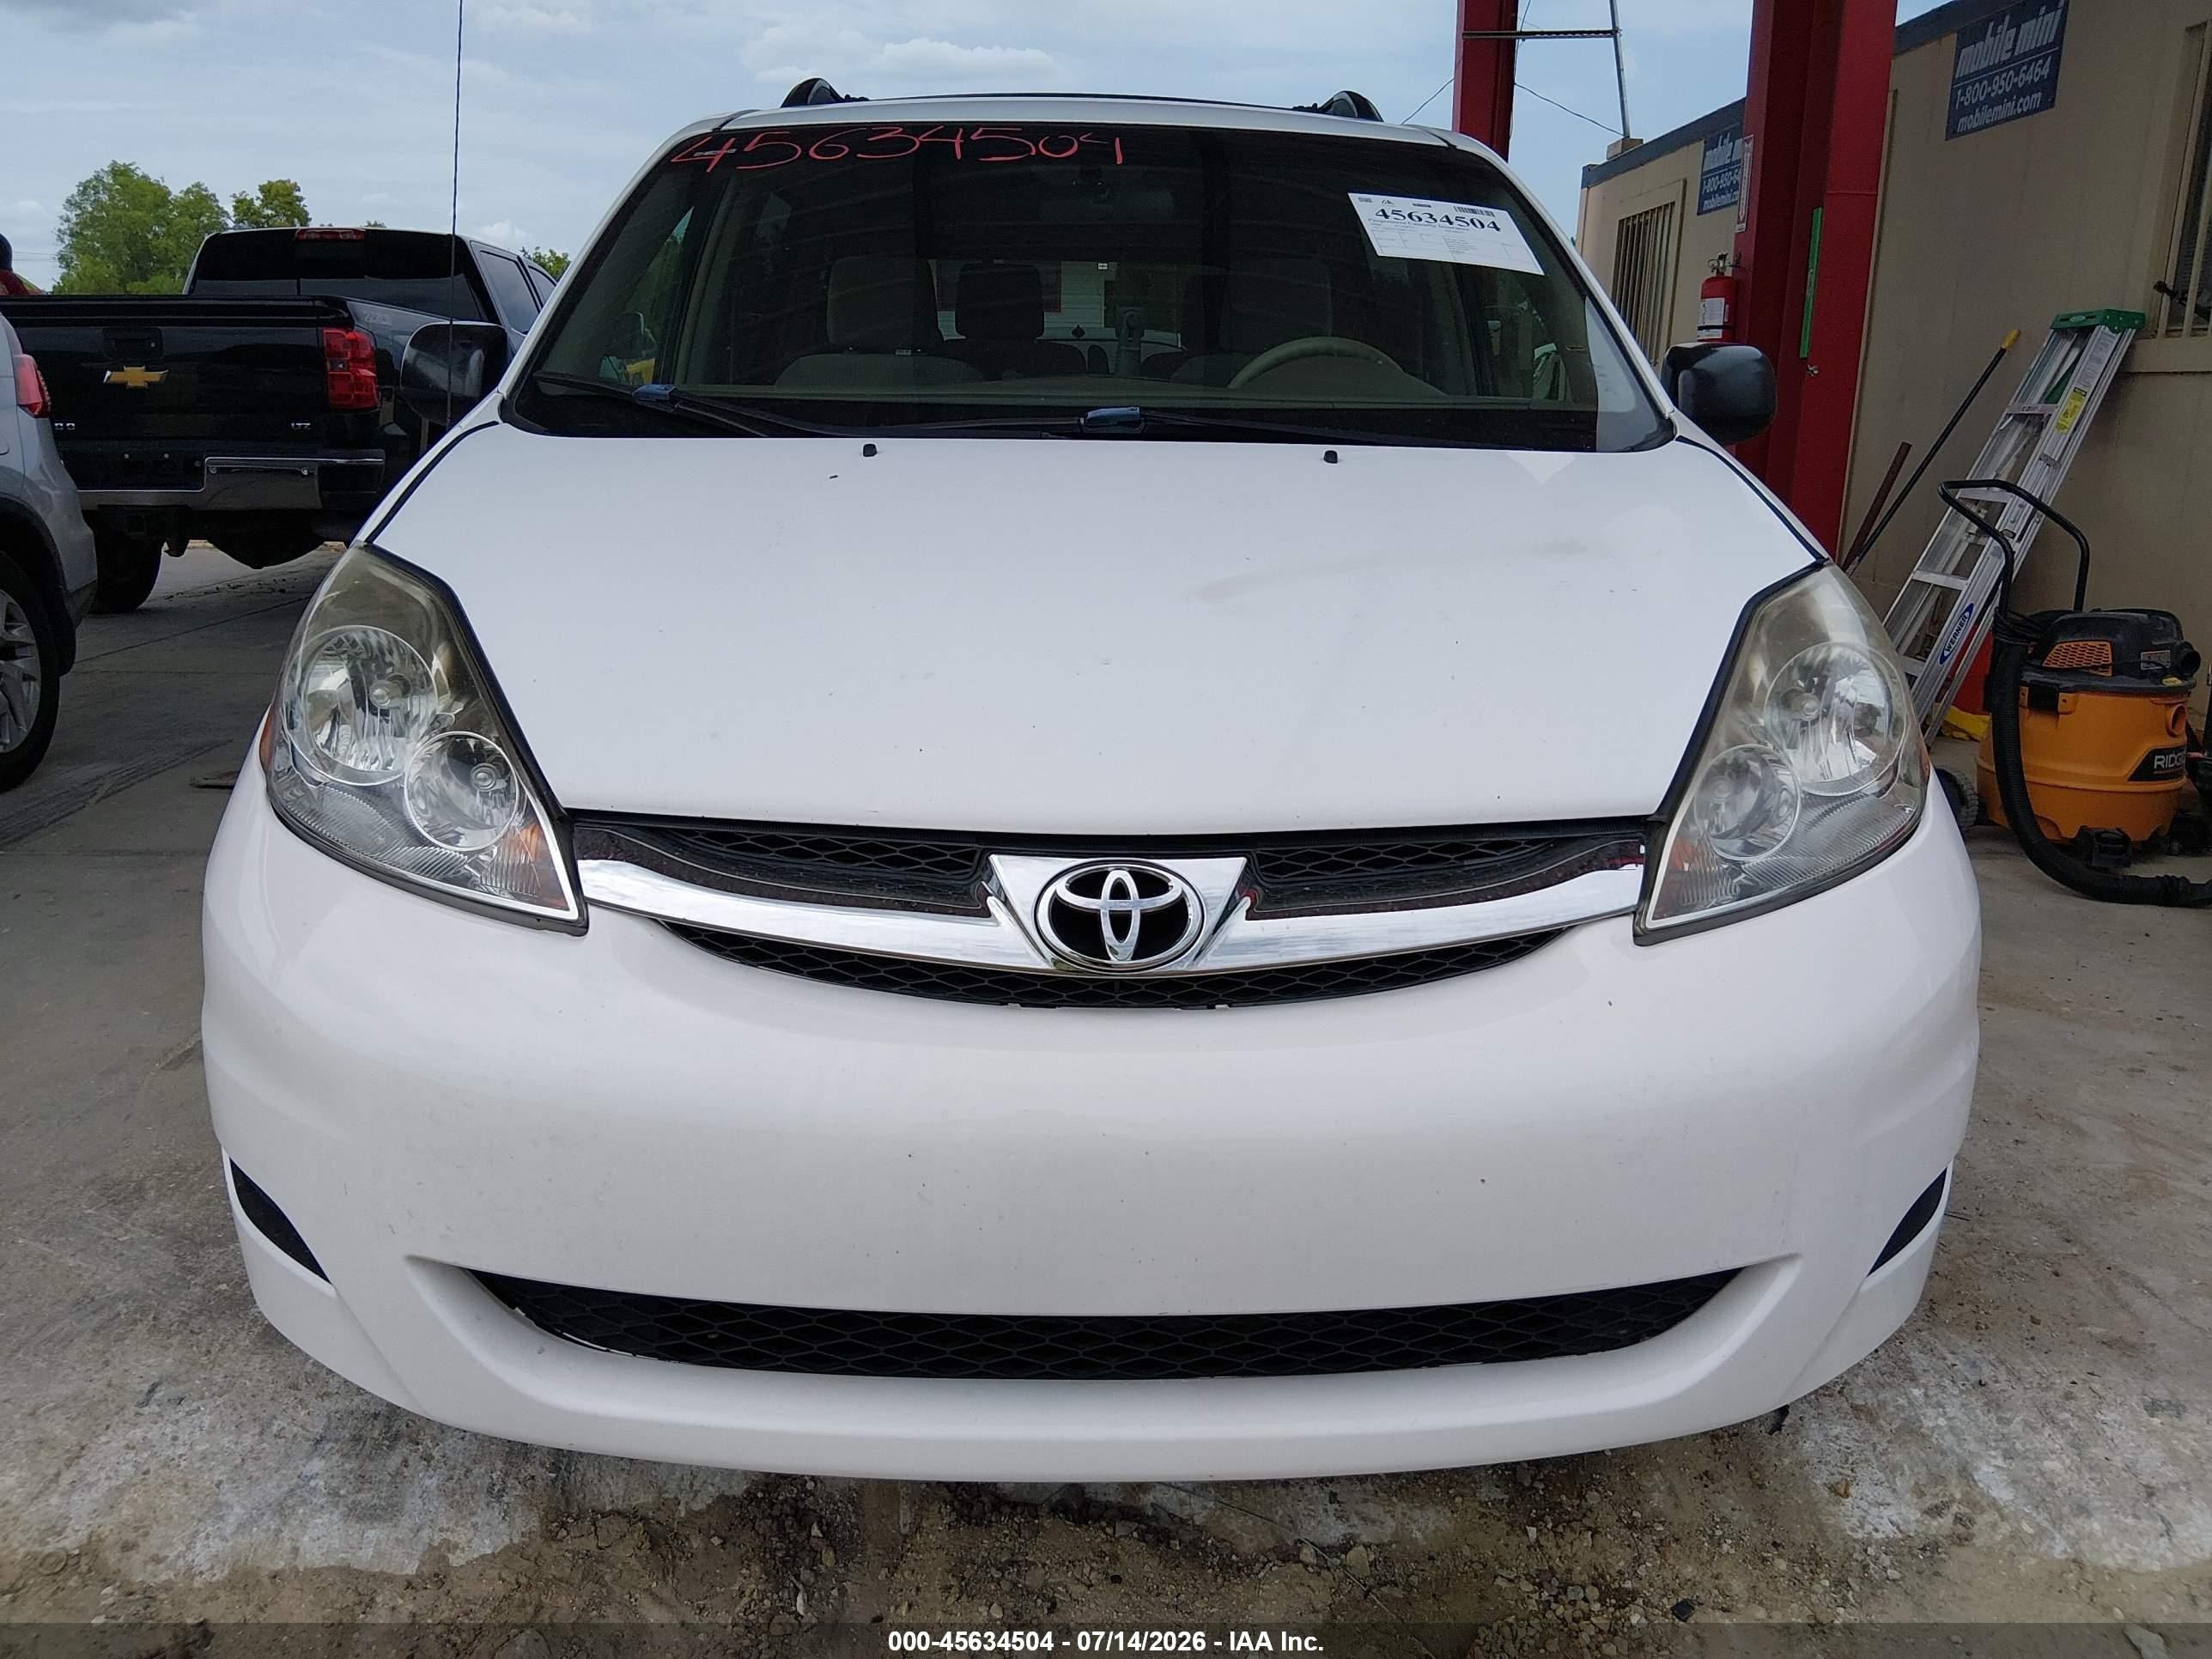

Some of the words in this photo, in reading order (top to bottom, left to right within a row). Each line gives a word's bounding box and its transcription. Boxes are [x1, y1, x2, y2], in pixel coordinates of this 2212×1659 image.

[1954, 14, 2016, 78] mobile
[2014, 0, 2064, 55] mini
[1955, 55, 2052, 110] 1-800-950-6464
[1957, 91, 2042, 132] mobilemini.com
[670, 125, 1122, 173] 45634504
[1703, 132, 1734, 173] mobile
[1375, 208, 1501, 232] 45634504
[1945, 615, 1967, 653] WERNER
